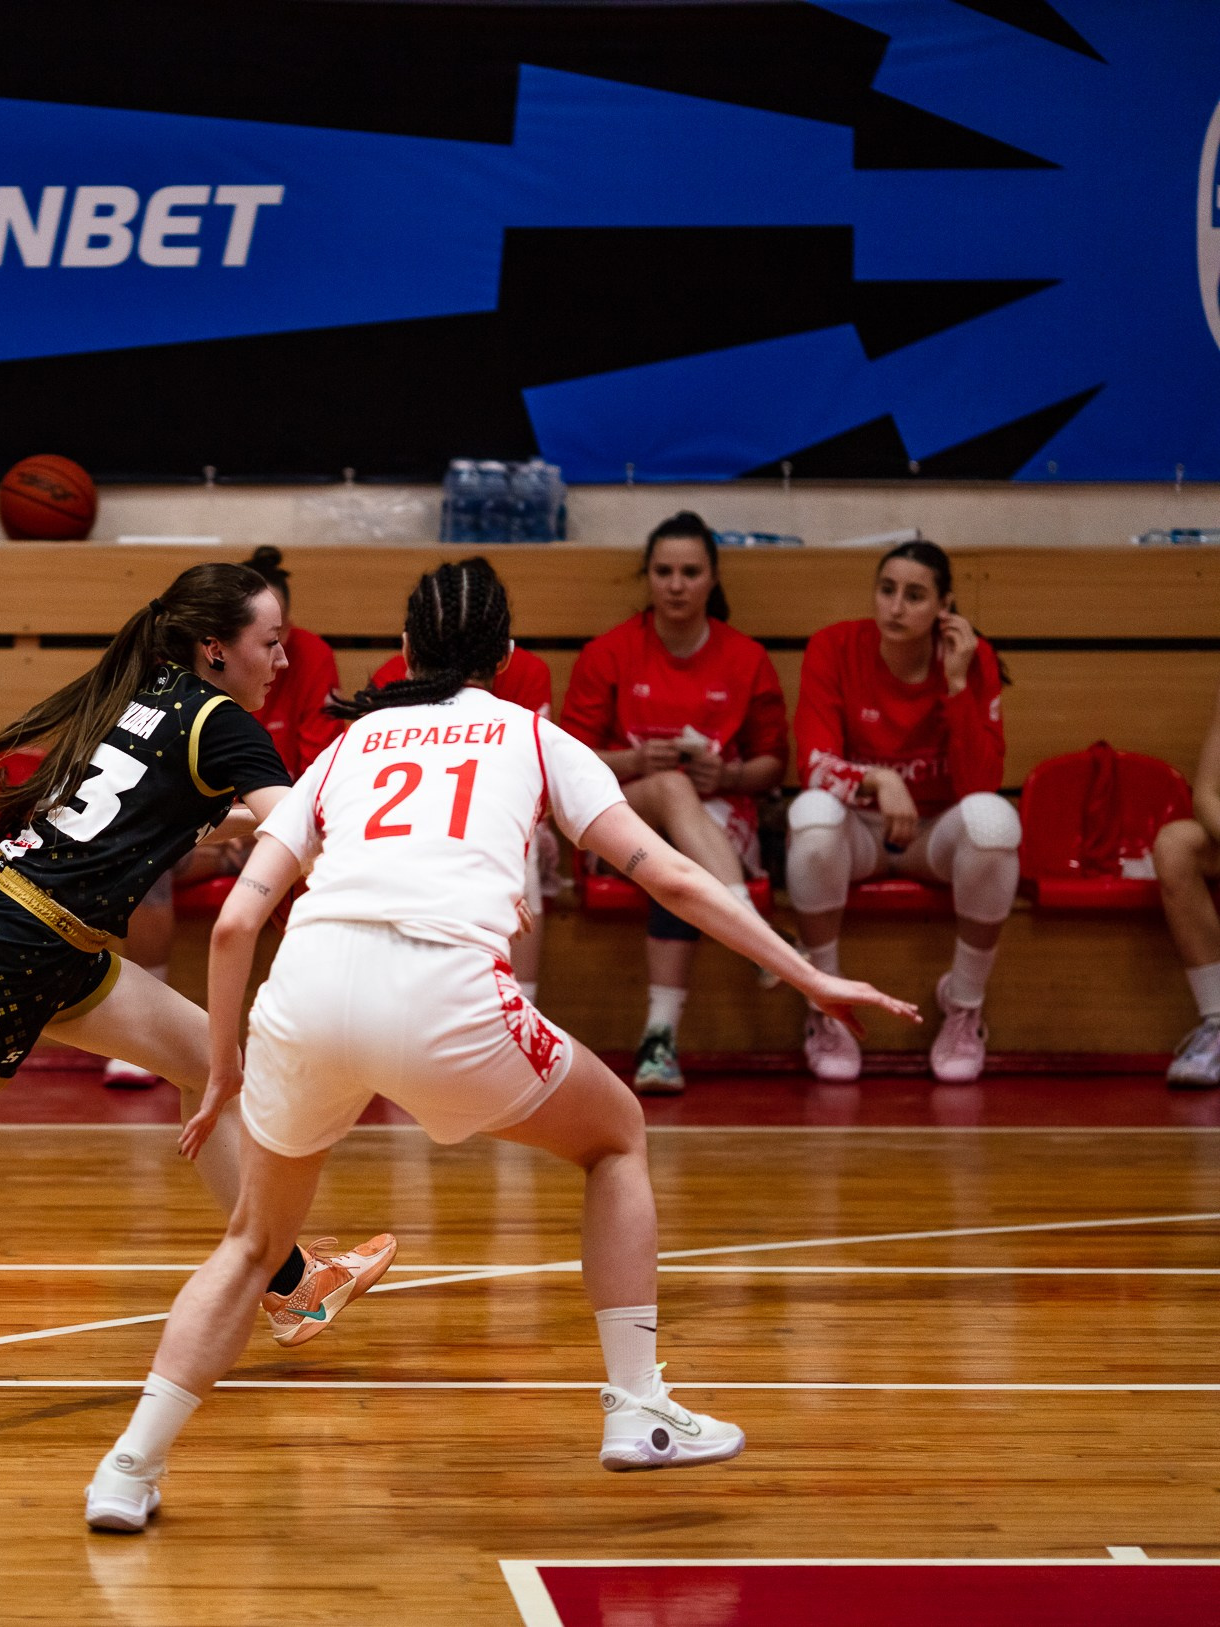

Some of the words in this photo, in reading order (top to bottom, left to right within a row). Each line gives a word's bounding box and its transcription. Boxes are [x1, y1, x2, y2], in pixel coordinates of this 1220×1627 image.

[362, 718, 506, 754] ВЕРАБЕЙ
[36, 742, 149, 843] 3
[364, 759, 478, 841] 21
